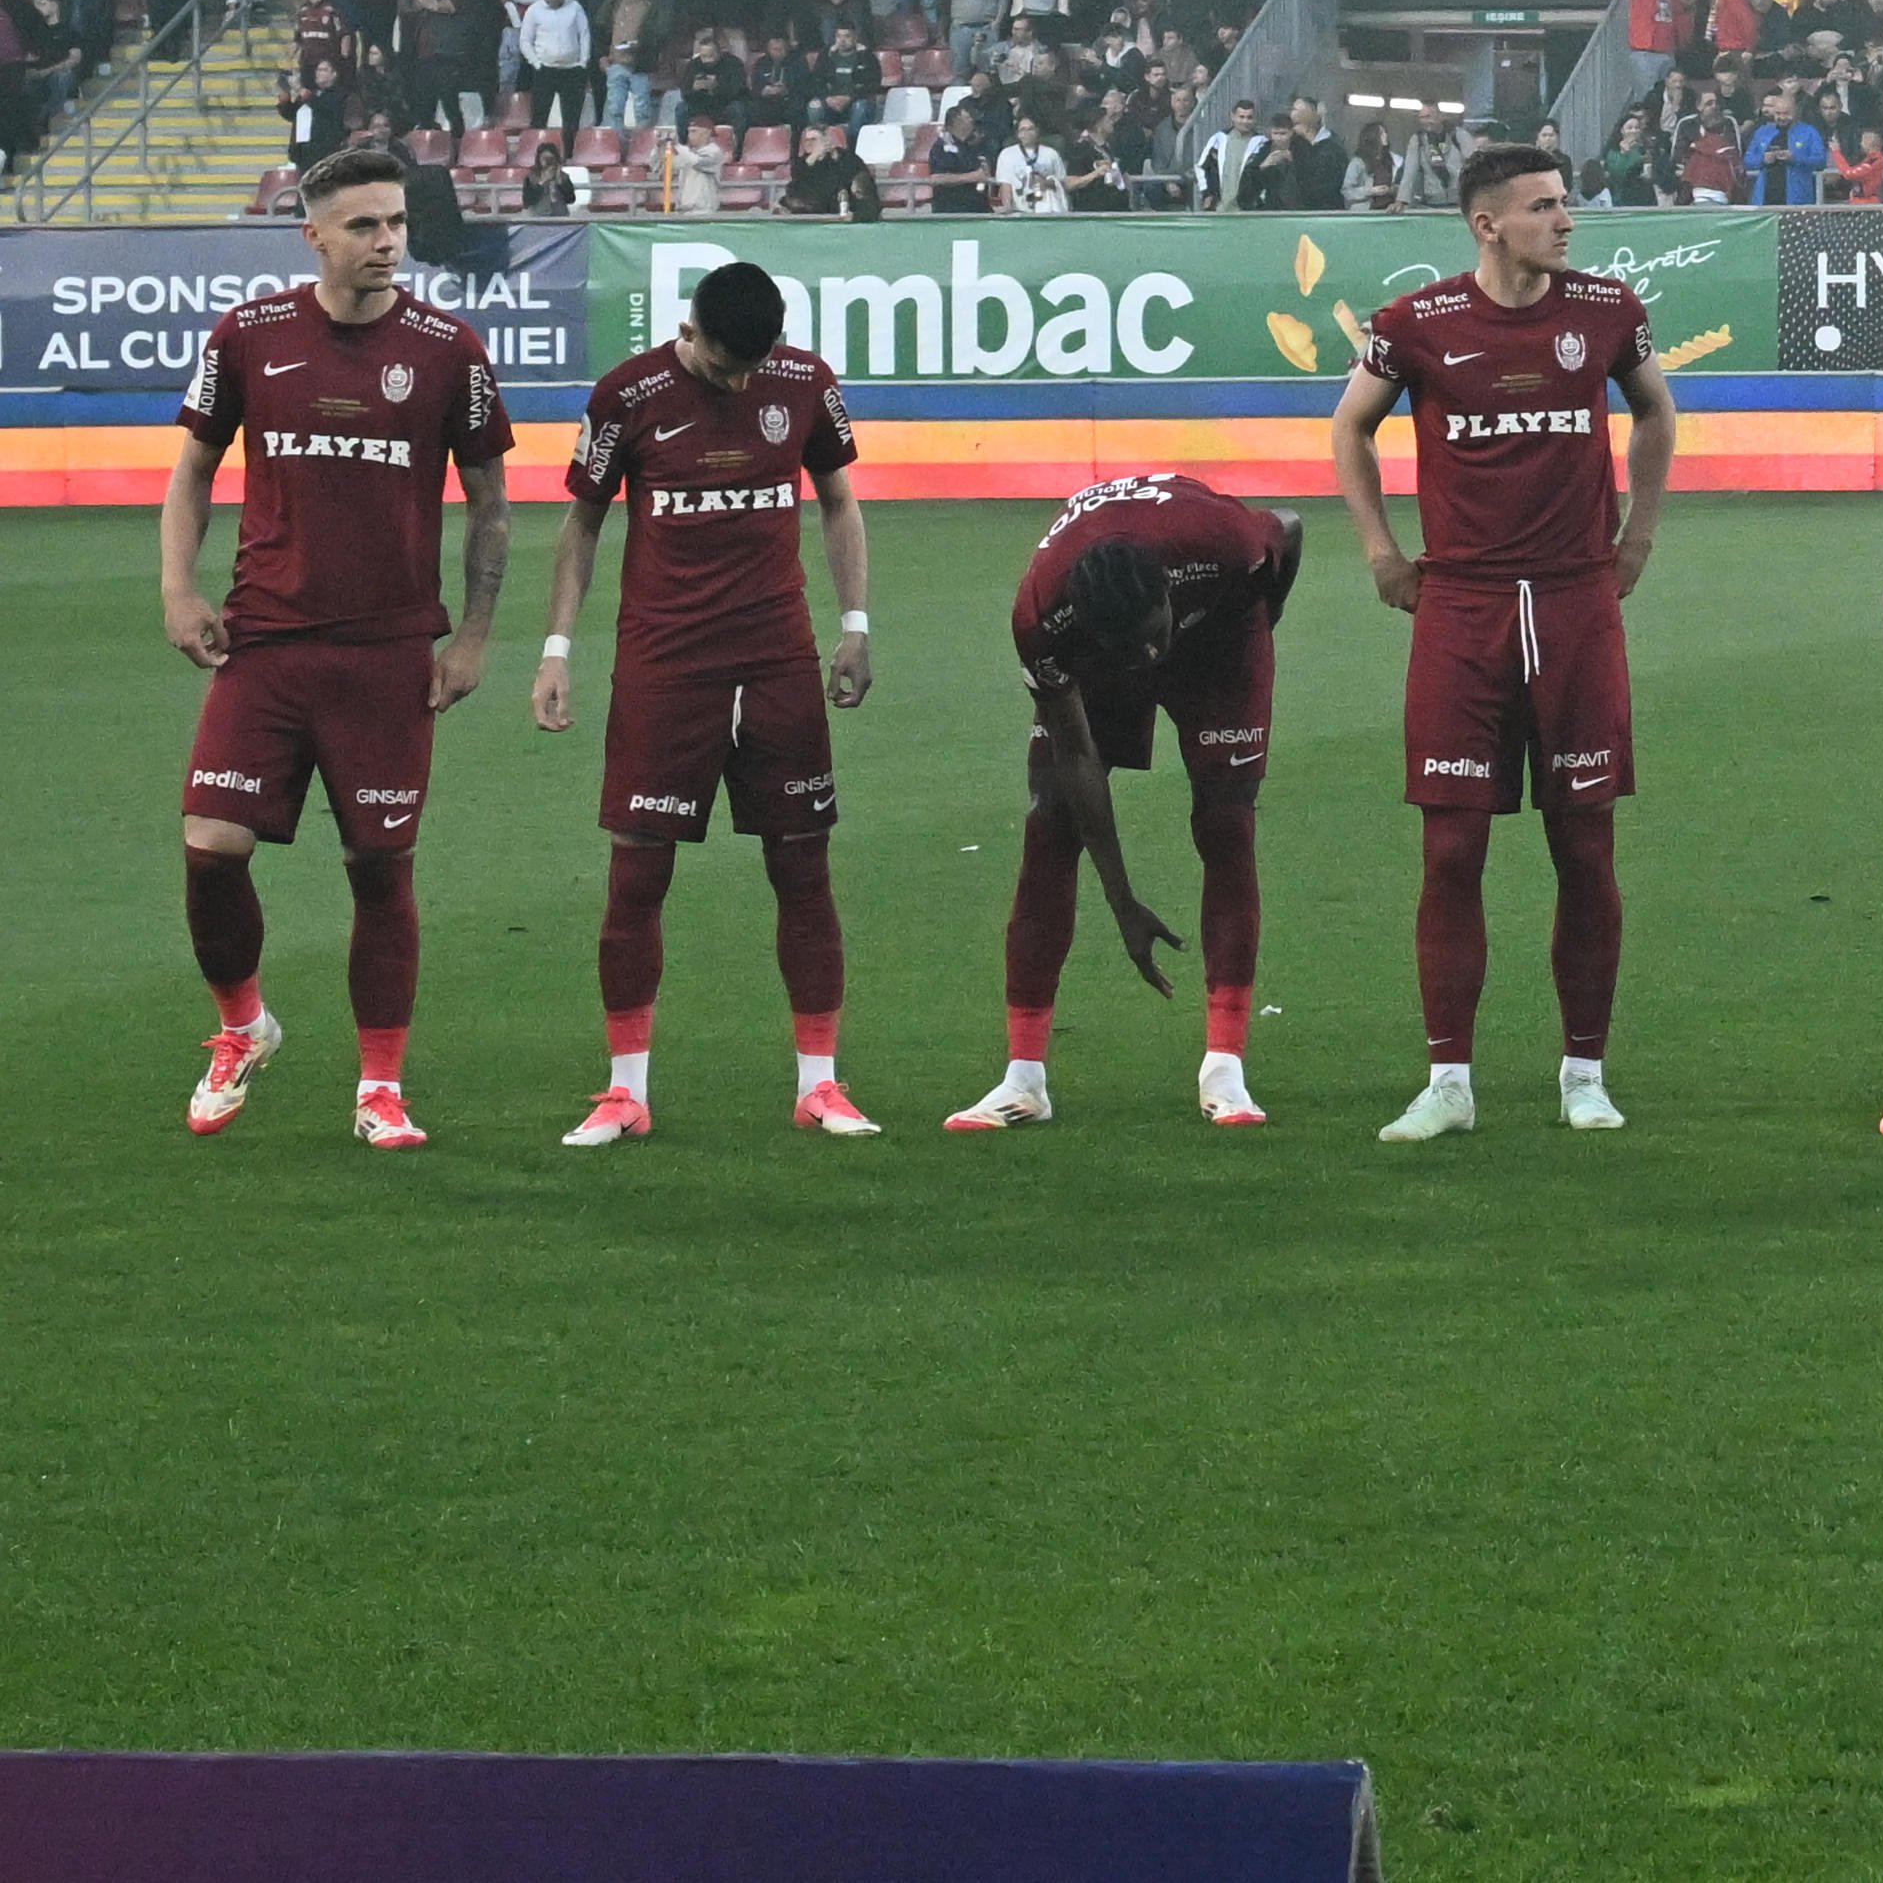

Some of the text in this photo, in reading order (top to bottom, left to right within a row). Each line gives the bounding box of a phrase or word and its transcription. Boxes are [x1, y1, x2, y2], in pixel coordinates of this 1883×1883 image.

[629, 293, 644, 329] DIN
[39, 331, 110, 369] AL
[198, 348, 220, 417] AQUAVIA
[468, 364, 482, 431] AQUAVIA
[823, 387, 853, 446] AQUAVIA
[1446, 408, 1593, 441] PLAYER
[263, 430, 411, 468] PLAYER
[588, 422, 623, 486] AQUAVIA
[651, 482, 795, 517] PLAYER
[1199, 727, 1265, 746] GINSAVIT
[1423, 757, 1492, 781] peditel
[1552, 749, 1612, 773] INSAVIT
[192, 768, 263, 797] peditel
[356, 788, 420, 806] GINSAVIT
[629, 793, 698, 818] peditel
